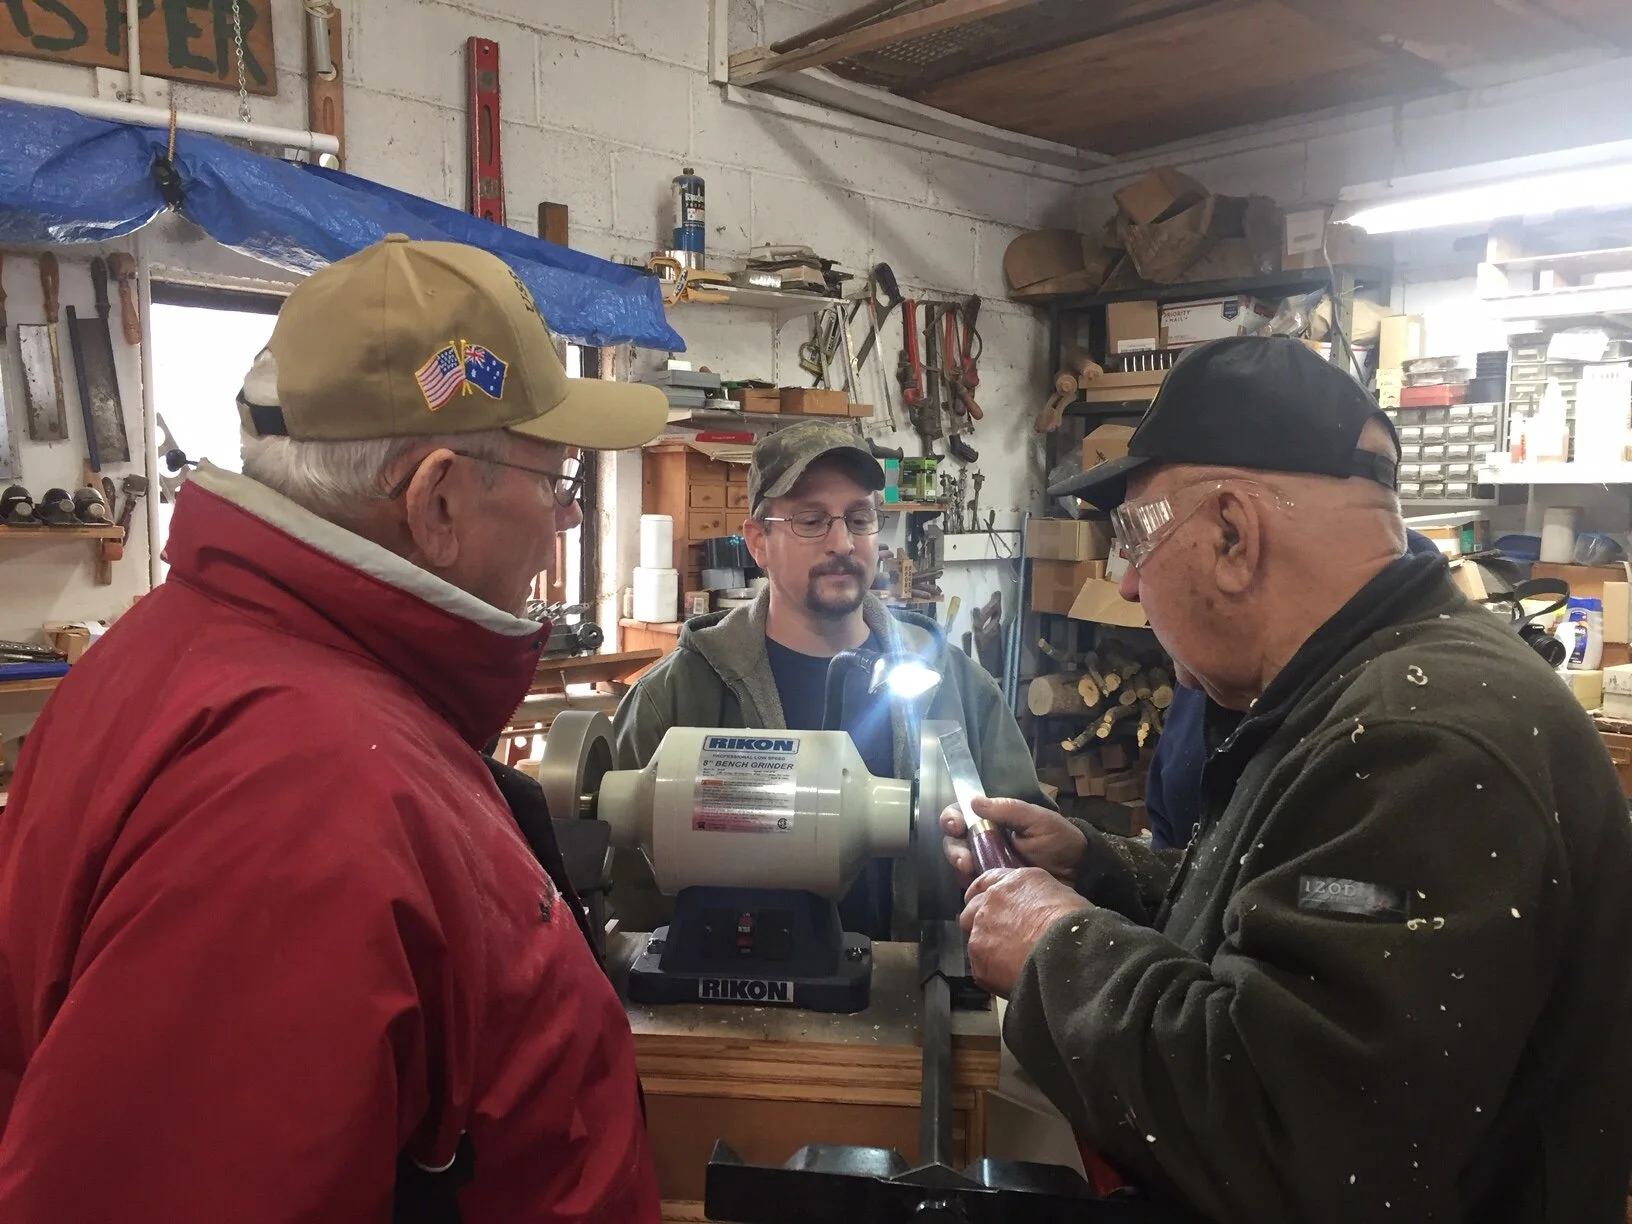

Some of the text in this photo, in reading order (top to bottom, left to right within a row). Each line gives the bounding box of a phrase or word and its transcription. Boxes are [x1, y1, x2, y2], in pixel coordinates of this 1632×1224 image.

[709, 738, 794, 752] RIKON
[715, 760, 749, 768] BENCH
[750, 762, 794, 770] GRINDER
[1305, 880, 1357, 897] IZOD
[702, 980, 788, 1001] RIKON
